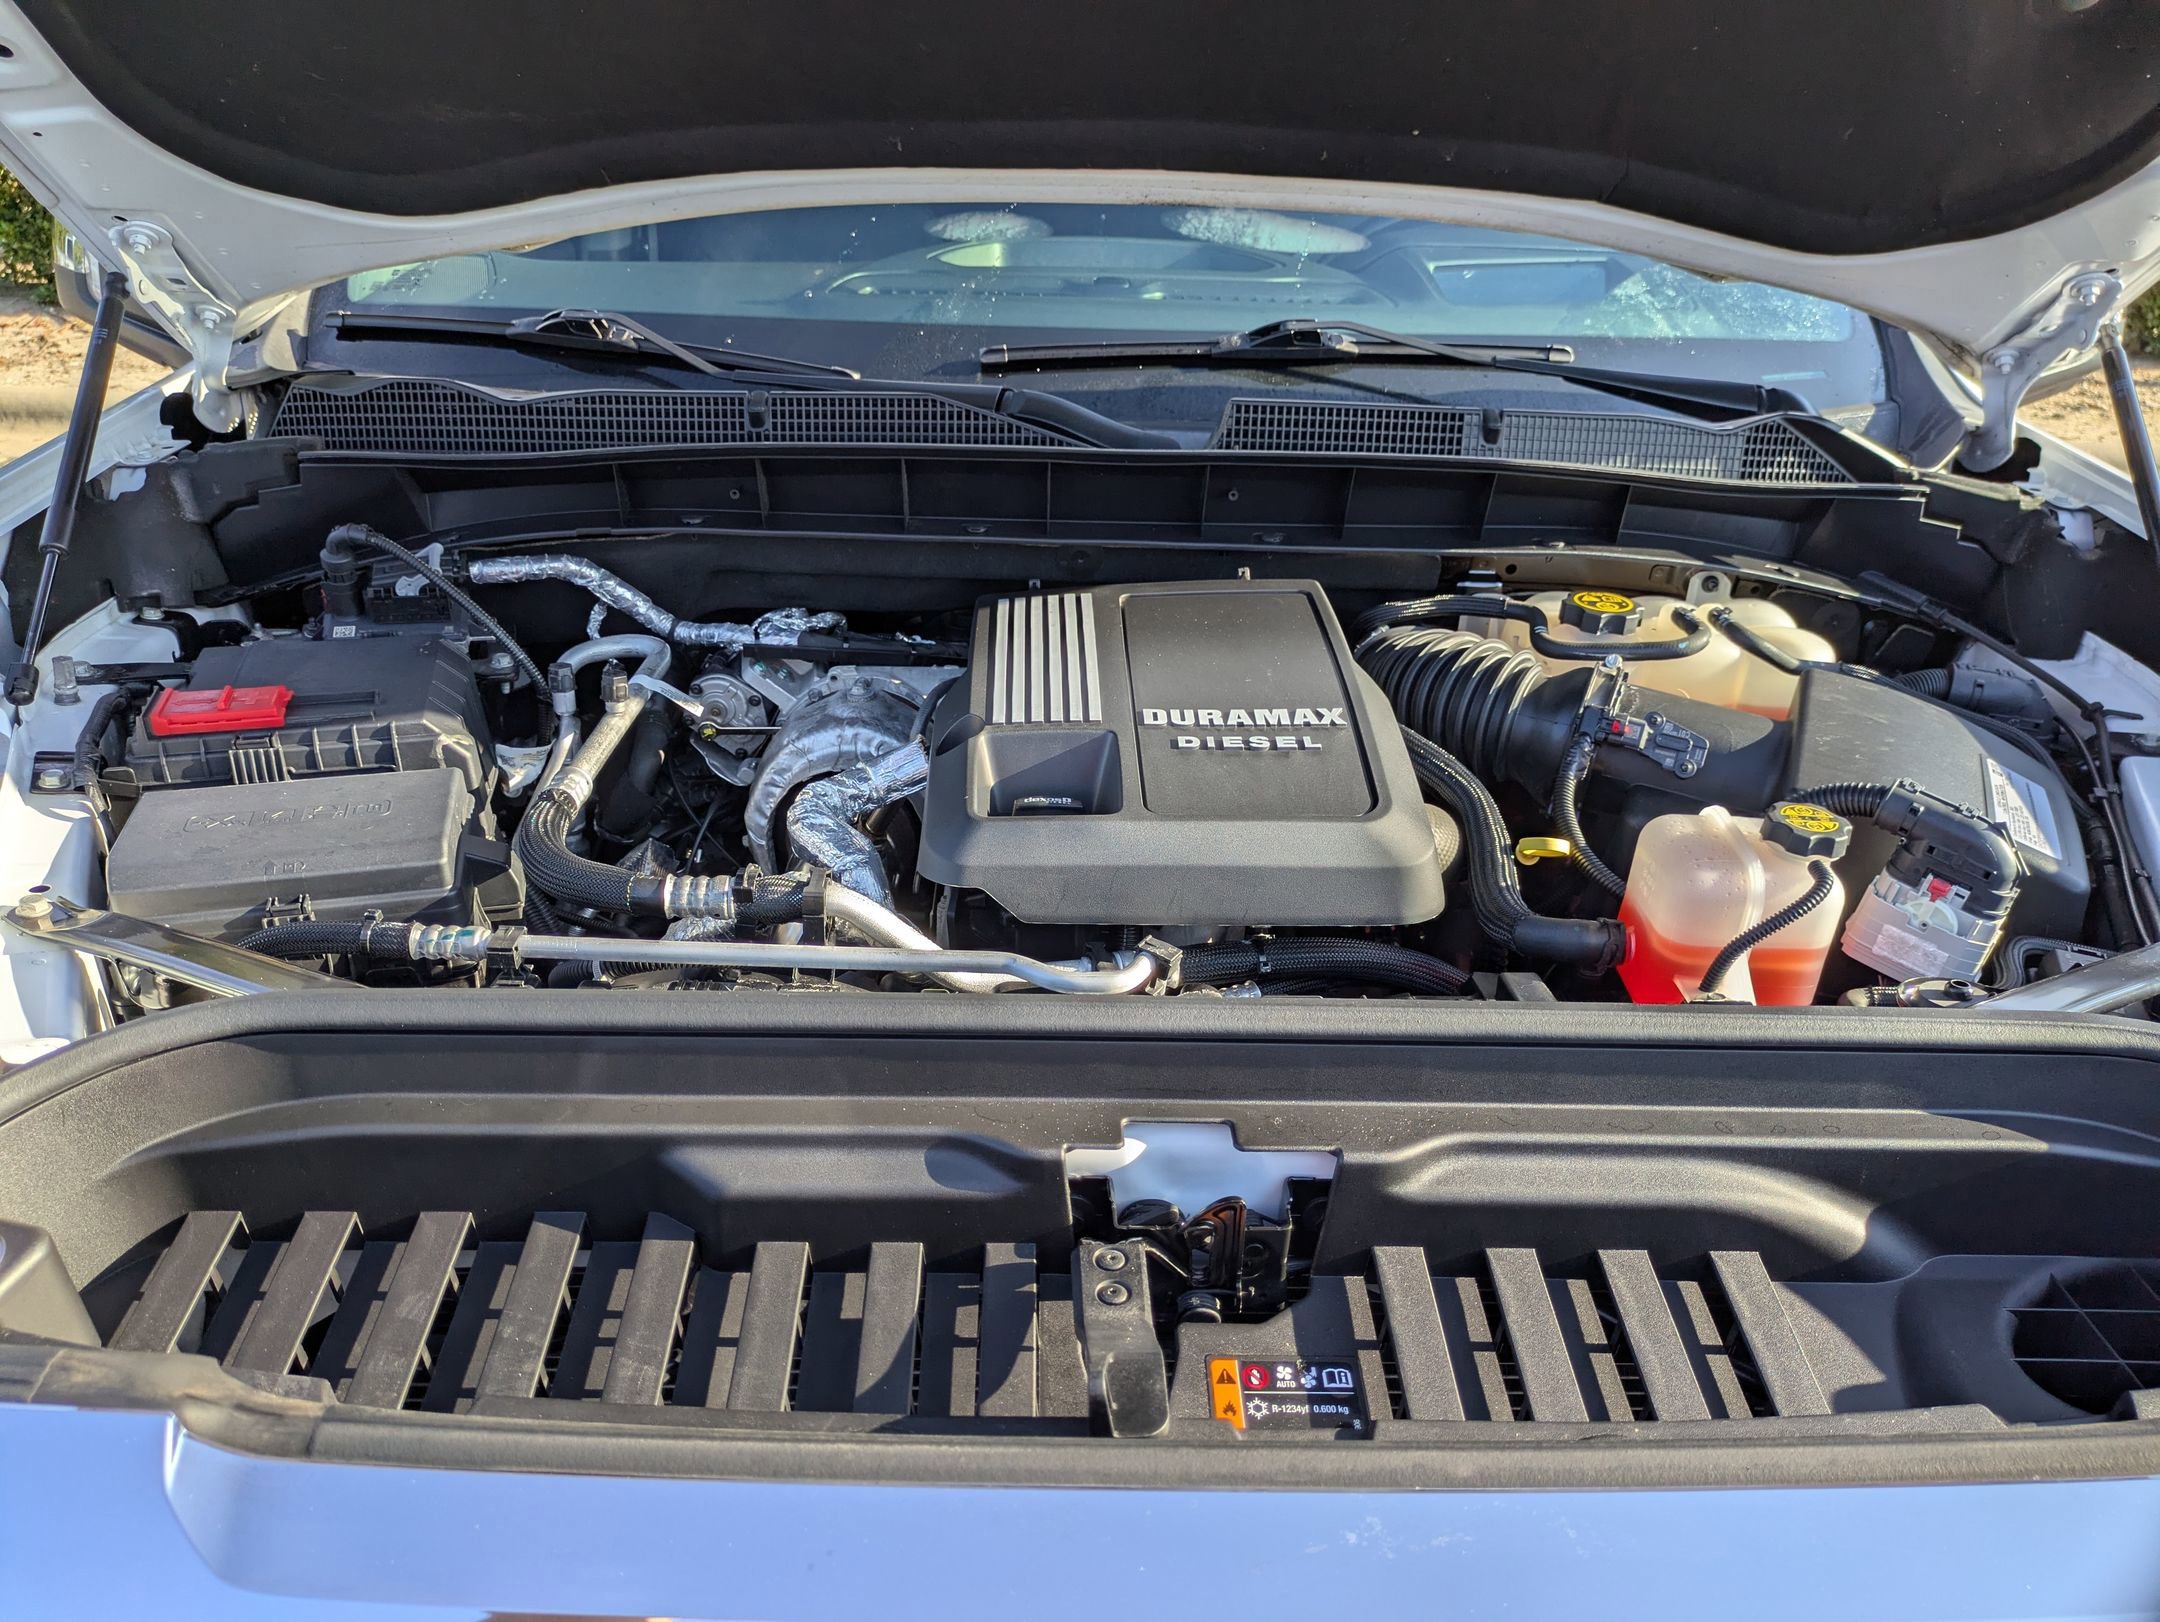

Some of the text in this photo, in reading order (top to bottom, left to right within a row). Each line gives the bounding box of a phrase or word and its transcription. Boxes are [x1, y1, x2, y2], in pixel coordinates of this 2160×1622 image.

[1142, 707, 1348, 728] DURAMAX
[1176, 735, 1323, 751] DIESEL
[1276, 1380, 1296, 1388] AUTO
[1271, 1404, 1349, 1415] R-1234yf 0.600 kg
